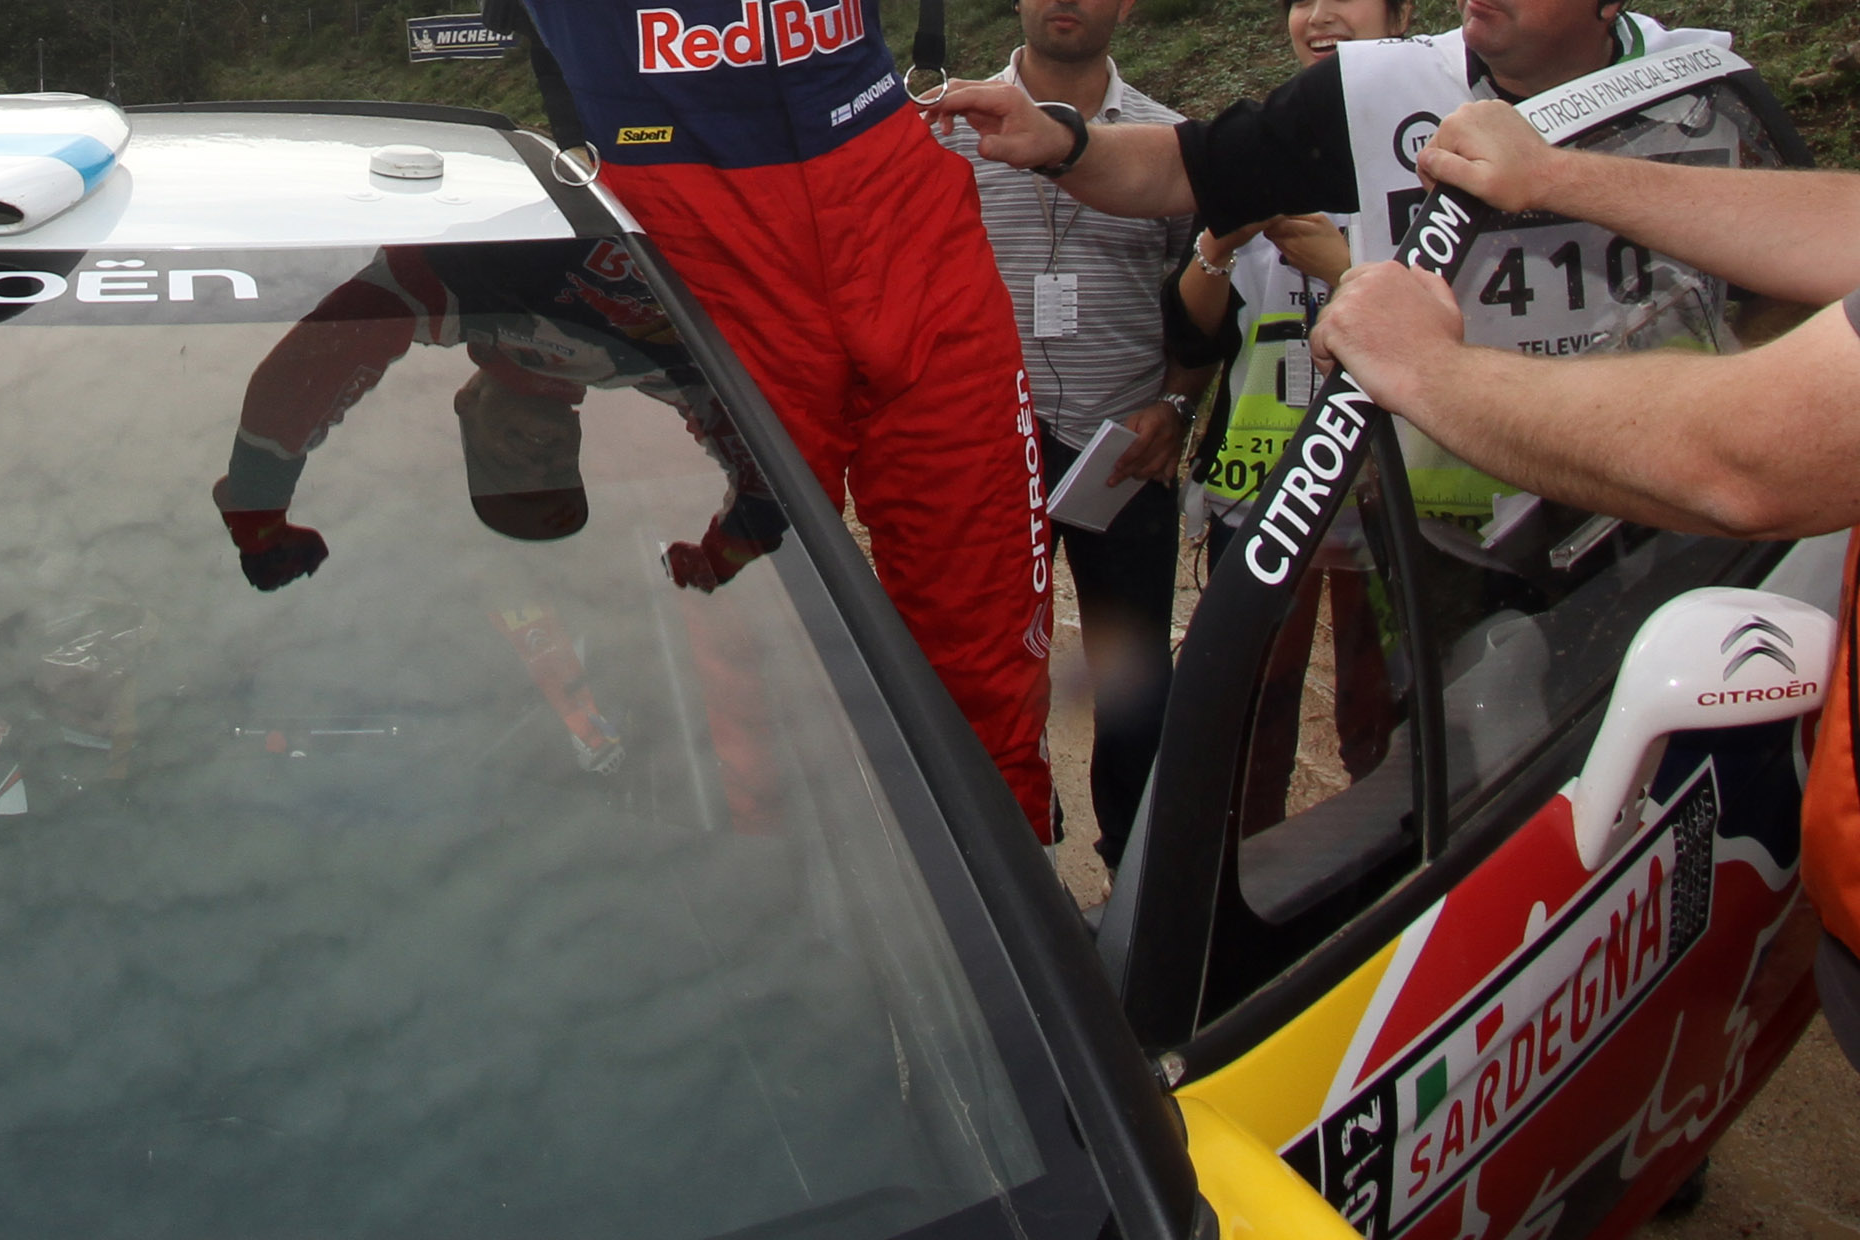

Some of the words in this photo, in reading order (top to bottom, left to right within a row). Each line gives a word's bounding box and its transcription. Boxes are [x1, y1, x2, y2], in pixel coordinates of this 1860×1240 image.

[1528, 89, 1601, 134] CITROËN
[1598, 64, 1671, 107] FINANCIAL
[1663, 48, 1722, 80] SERVICES
[623, 129, 667, 141] Sabelt
[1480, 235, 1653, 316] 410
[1251, 437, 1274, 455] 21
[1408, 852, 1665, 1199] SARDEGNA
